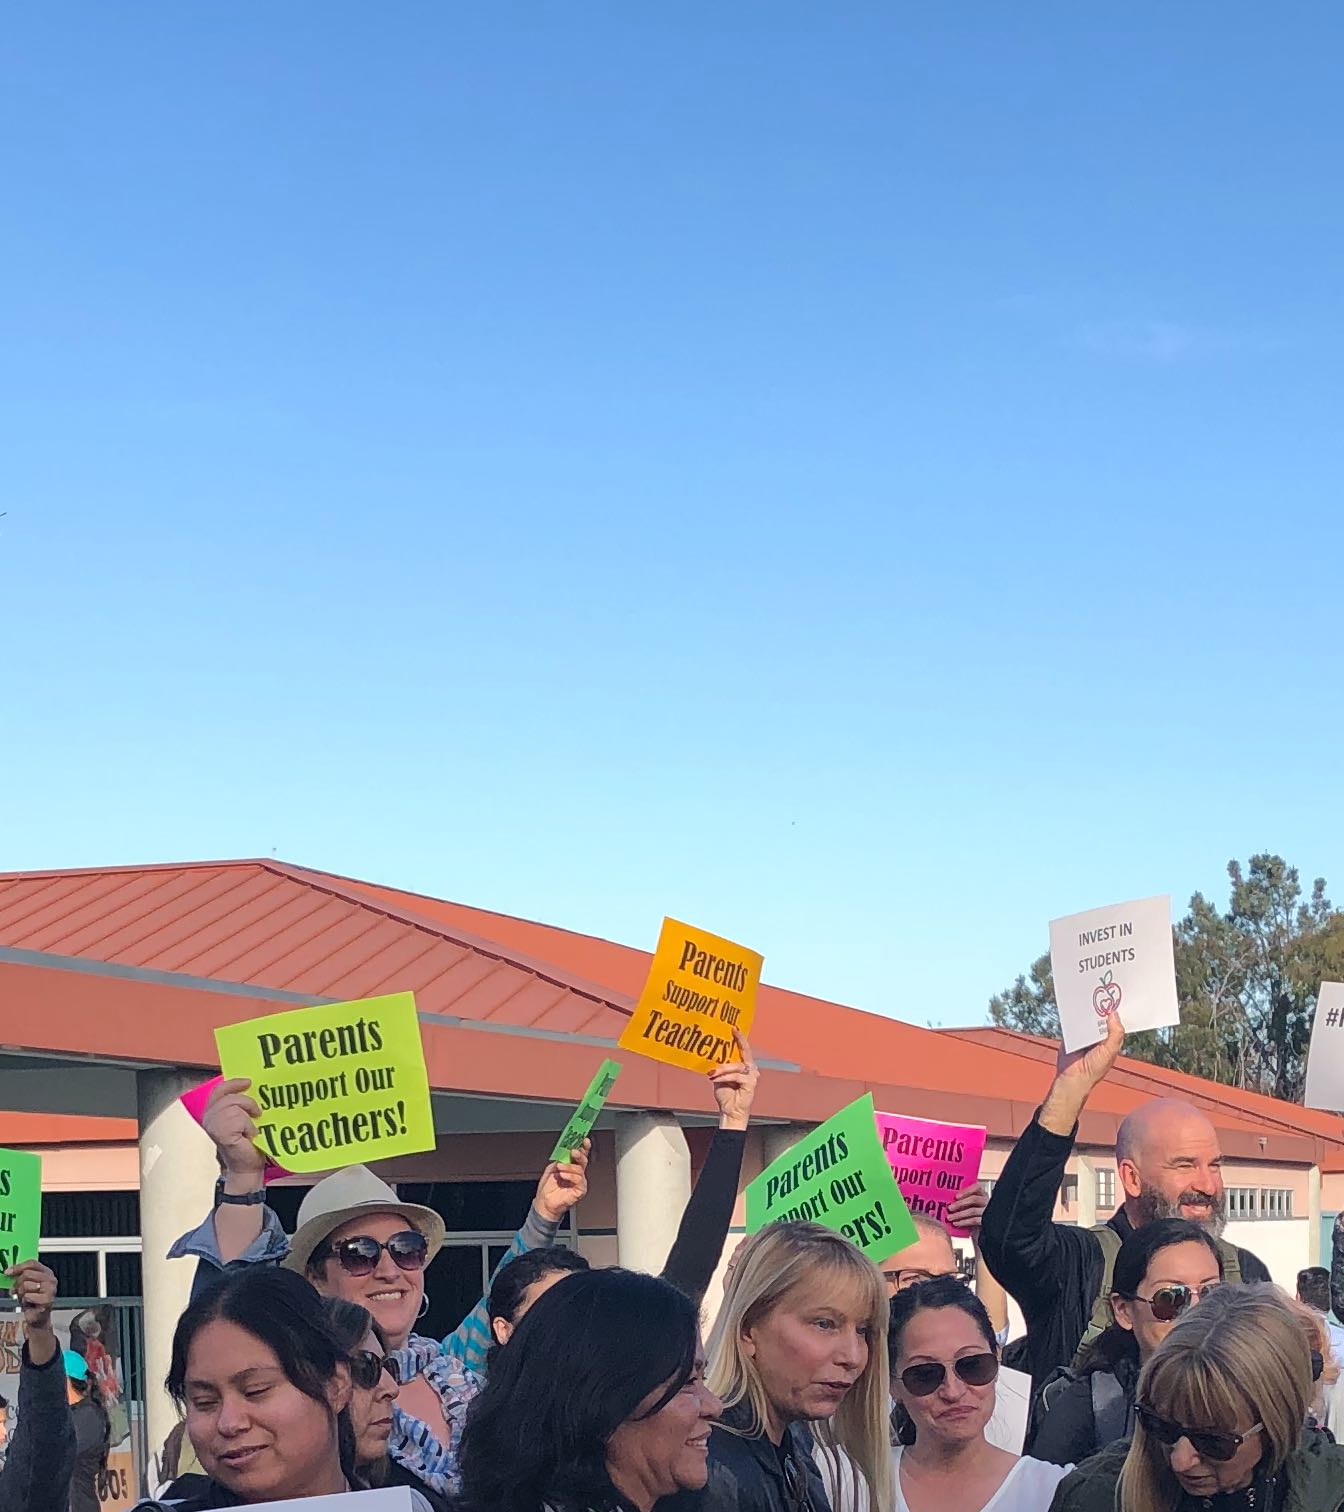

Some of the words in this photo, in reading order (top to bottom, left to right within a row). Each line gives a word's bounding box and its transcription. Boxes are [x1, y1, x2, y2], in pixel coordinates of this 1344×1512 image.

[1078, 926, 1116, 947] INVEST
[1119, 922, 1133, 937] IN
[678, 940, 748, 992] Parents
[1078, 947, 1135, 973] STUDENTS
[662, 979, 719, 1018] Support
[720, 1000, 741, 1026] Our
[257, 1017, 383, 1069] Parents
[643, 1009, 736, 1064] Teachers!
[258, 1071, 348, 1110] Support
[355, 1066, 396, 1094] Our
[258, 1100, 407, 1157] Teachers!
[882, 1127, 965, 1163] Parents
[766, 1131, 849, 1210] Parents
[830, 1170, 867, 1205] Our
[936, 1170, 965, 1191] Our
